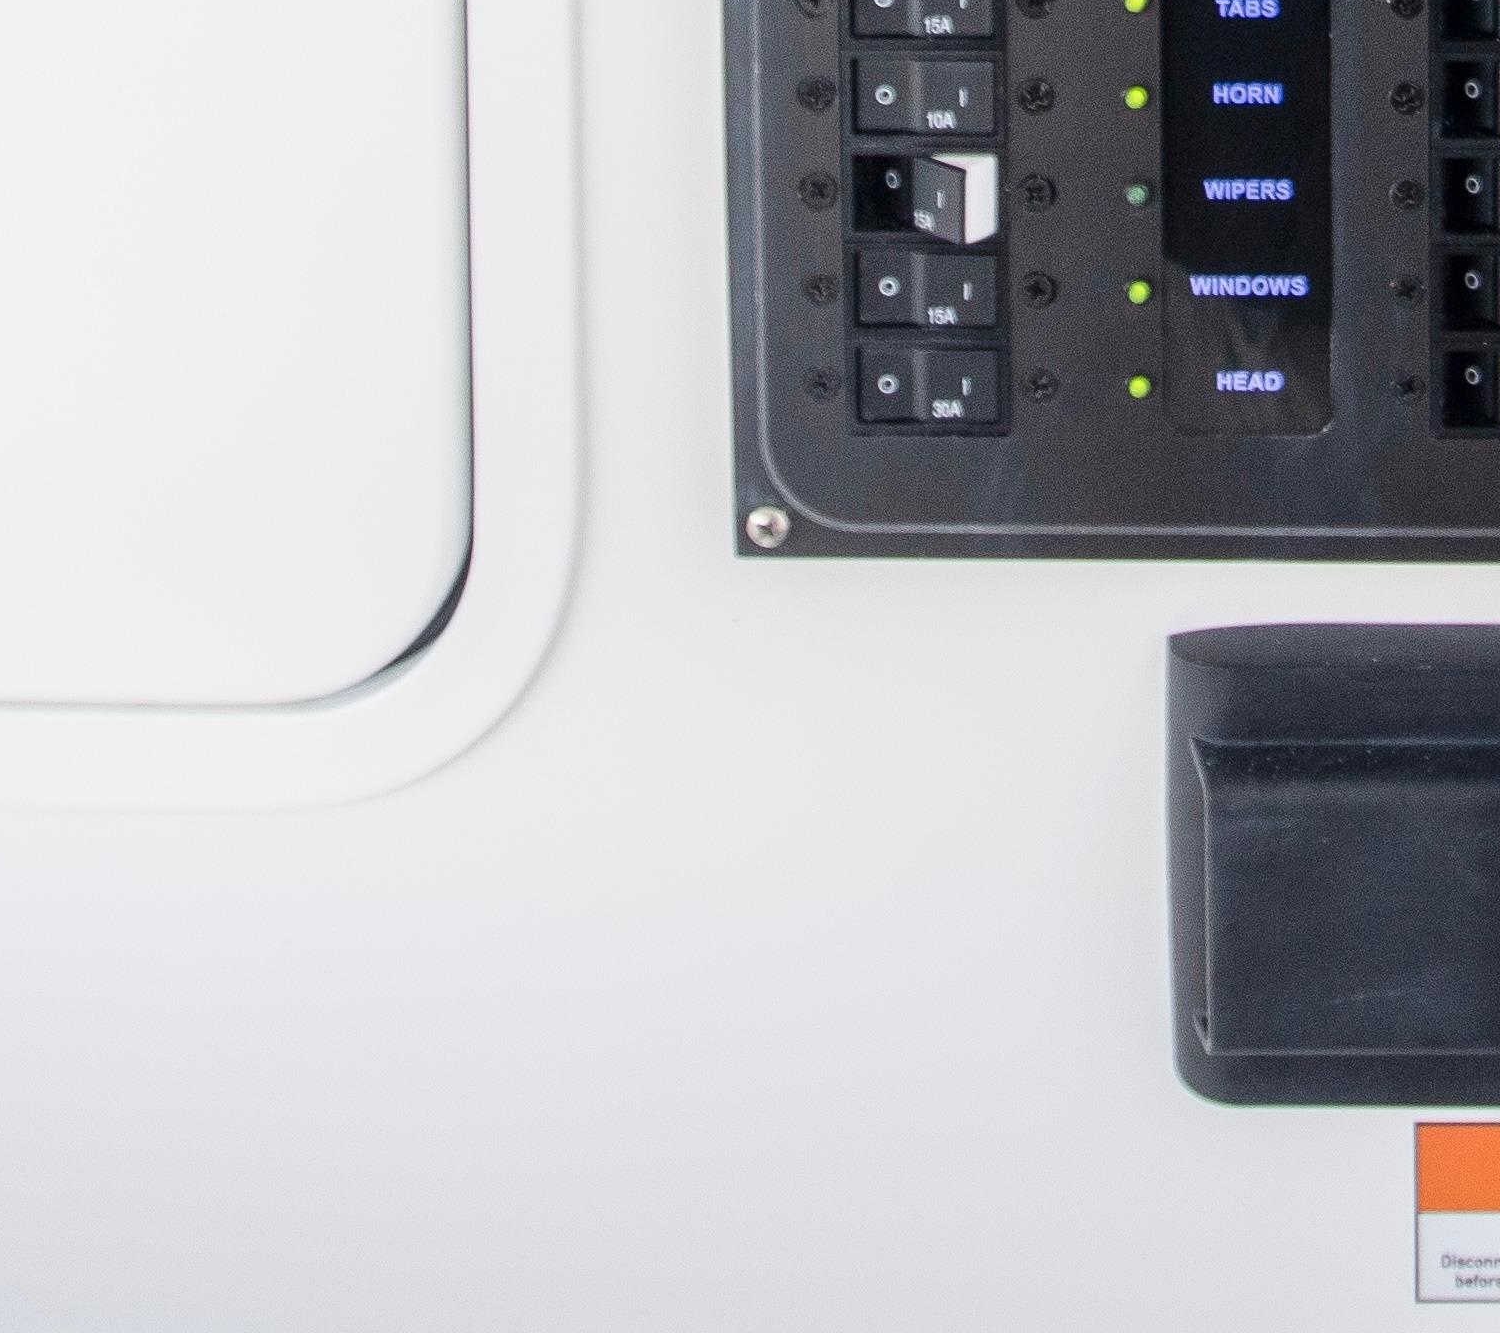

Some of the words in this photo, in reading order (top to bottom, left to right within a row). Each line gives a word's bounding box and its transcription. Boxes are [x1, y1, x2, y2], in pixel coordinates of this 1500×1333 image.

[924, 17, 952, 34] 15A
[1213, 84, 1282, 105] HORN
[927, 112, 953, 129] 10A
[1204, 180, 1294, 200] WIPERS
[1189, 275, 1308, 296] WINDOWS
[928, 308, 955, 325] 15A
[1217, 372, 1283, 392] HEAD
